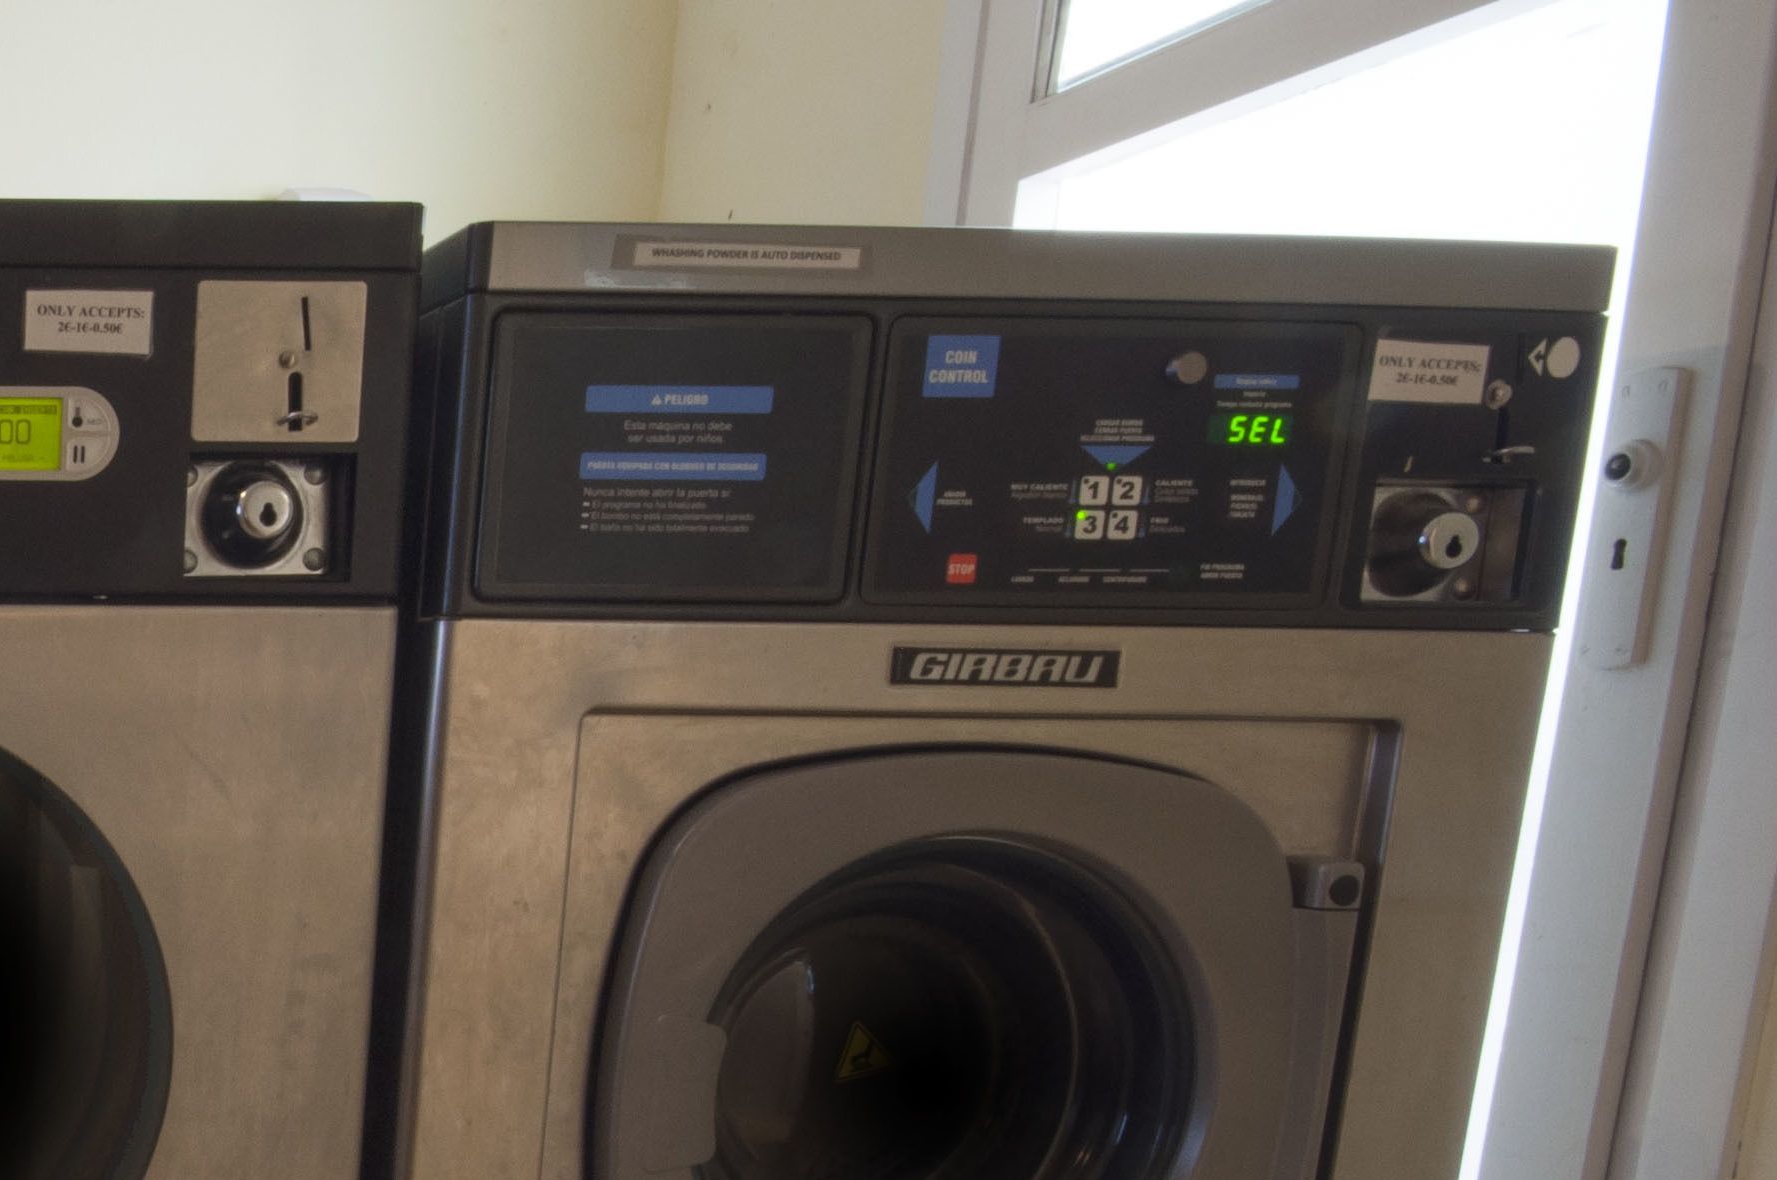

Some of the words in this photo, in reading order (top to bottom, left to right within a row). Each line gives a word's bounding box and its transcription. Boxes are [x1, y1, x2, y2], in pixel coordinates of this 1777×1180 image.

[651, 247, 704, 259] WHASHING
[706, 249, 749, 260] POWDER
[750, 250, 759, 260] IS
[761, 250, 789, 260] AUTO
[790, 251, 841, 261] DISPENSED
[37, 304, 76, 317] ONLY
[78, 305, 145, 319] ACCEPTS:
[945, 350, 978, 364] COIN
[1379, 355, 1416, 369] ONLY
[929, 368, 989, 384] CONTROL
[1227, 415, 1286, 445] SEL
[1088, 481, 1100, 499] 1
[1119, 481, 1135, 500] 2
[1083, 515, 1098, 534] 3
[1114, 515, 1129, 534] 4
[948, 563, 976, 575] STOP
[909, 652, 1105, 684] GIRBAU
